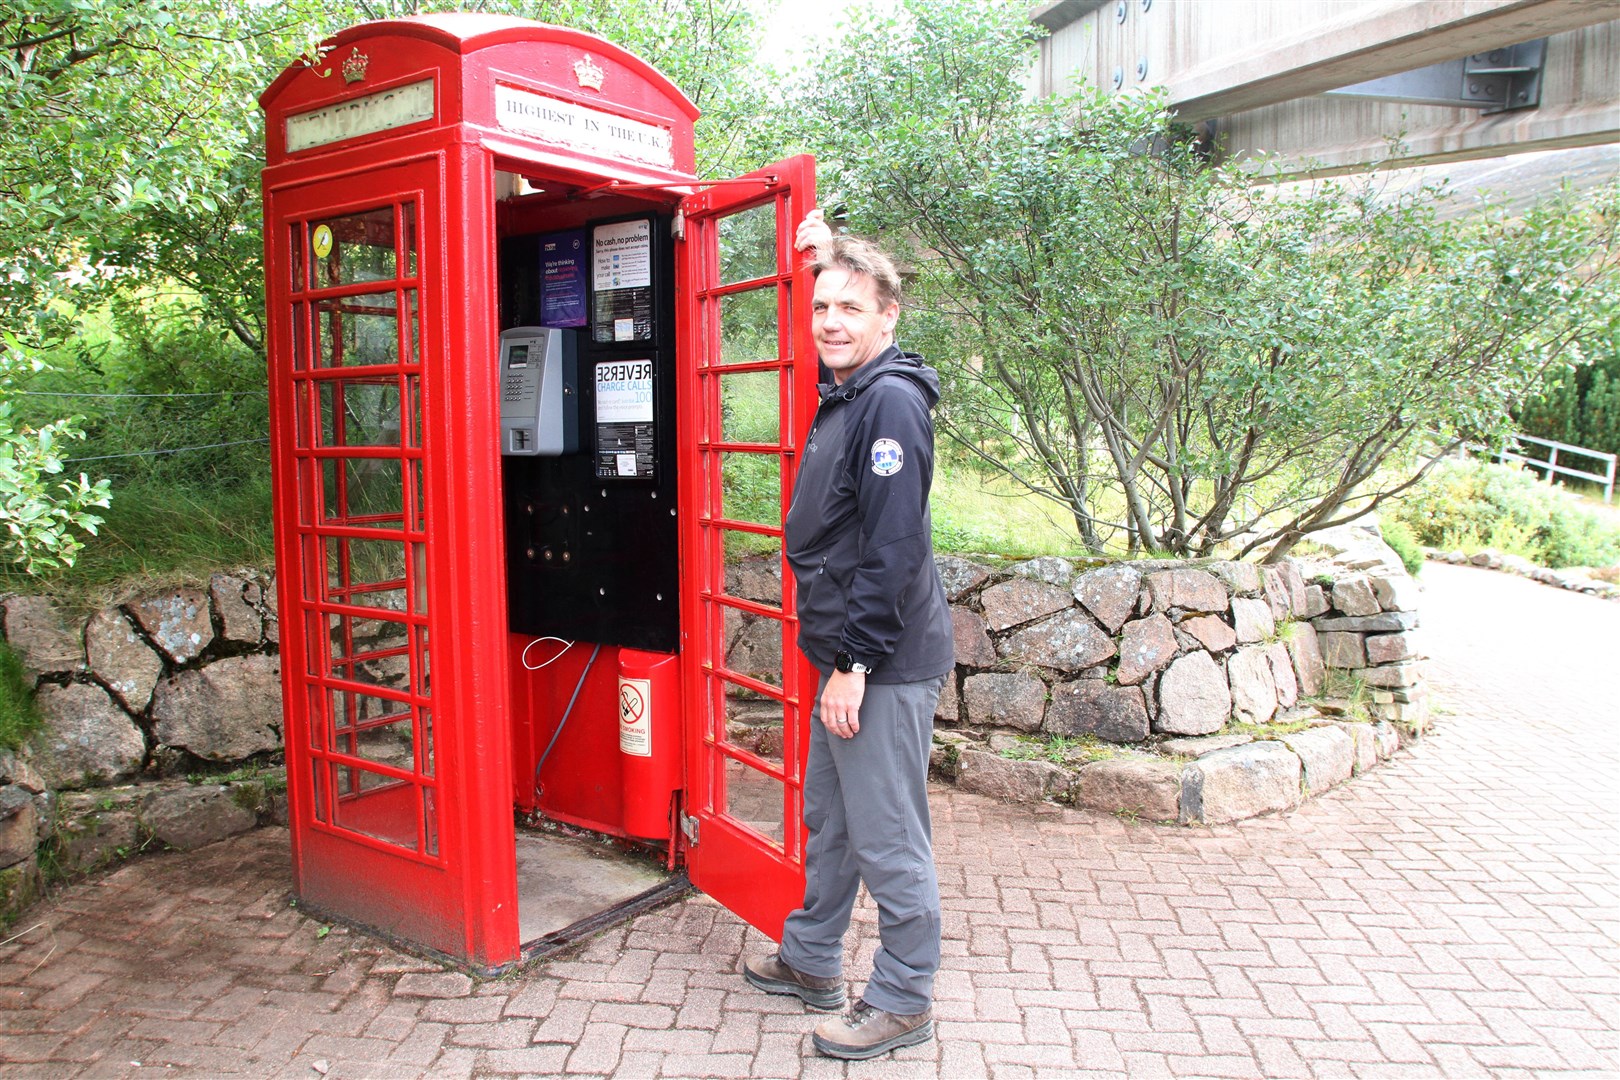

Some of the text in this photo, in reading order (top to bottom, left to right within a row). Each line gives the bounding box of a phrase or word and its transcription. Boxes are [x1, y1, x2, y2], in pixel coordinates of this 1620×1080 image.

[506, 100, 664, 149] HIGHEST IN THE U.K.
[595, 239, 604, 247] No
[604, 238, 618, 246] cash,
[624, 234, 648, 246] problem
[545, 258, 575, 268] We're thinking
[597, 380, 652, 393] CHARGE CALLS
[635, 391, 652, 404] 100
[622, 726, 646, 734] SMOKING
